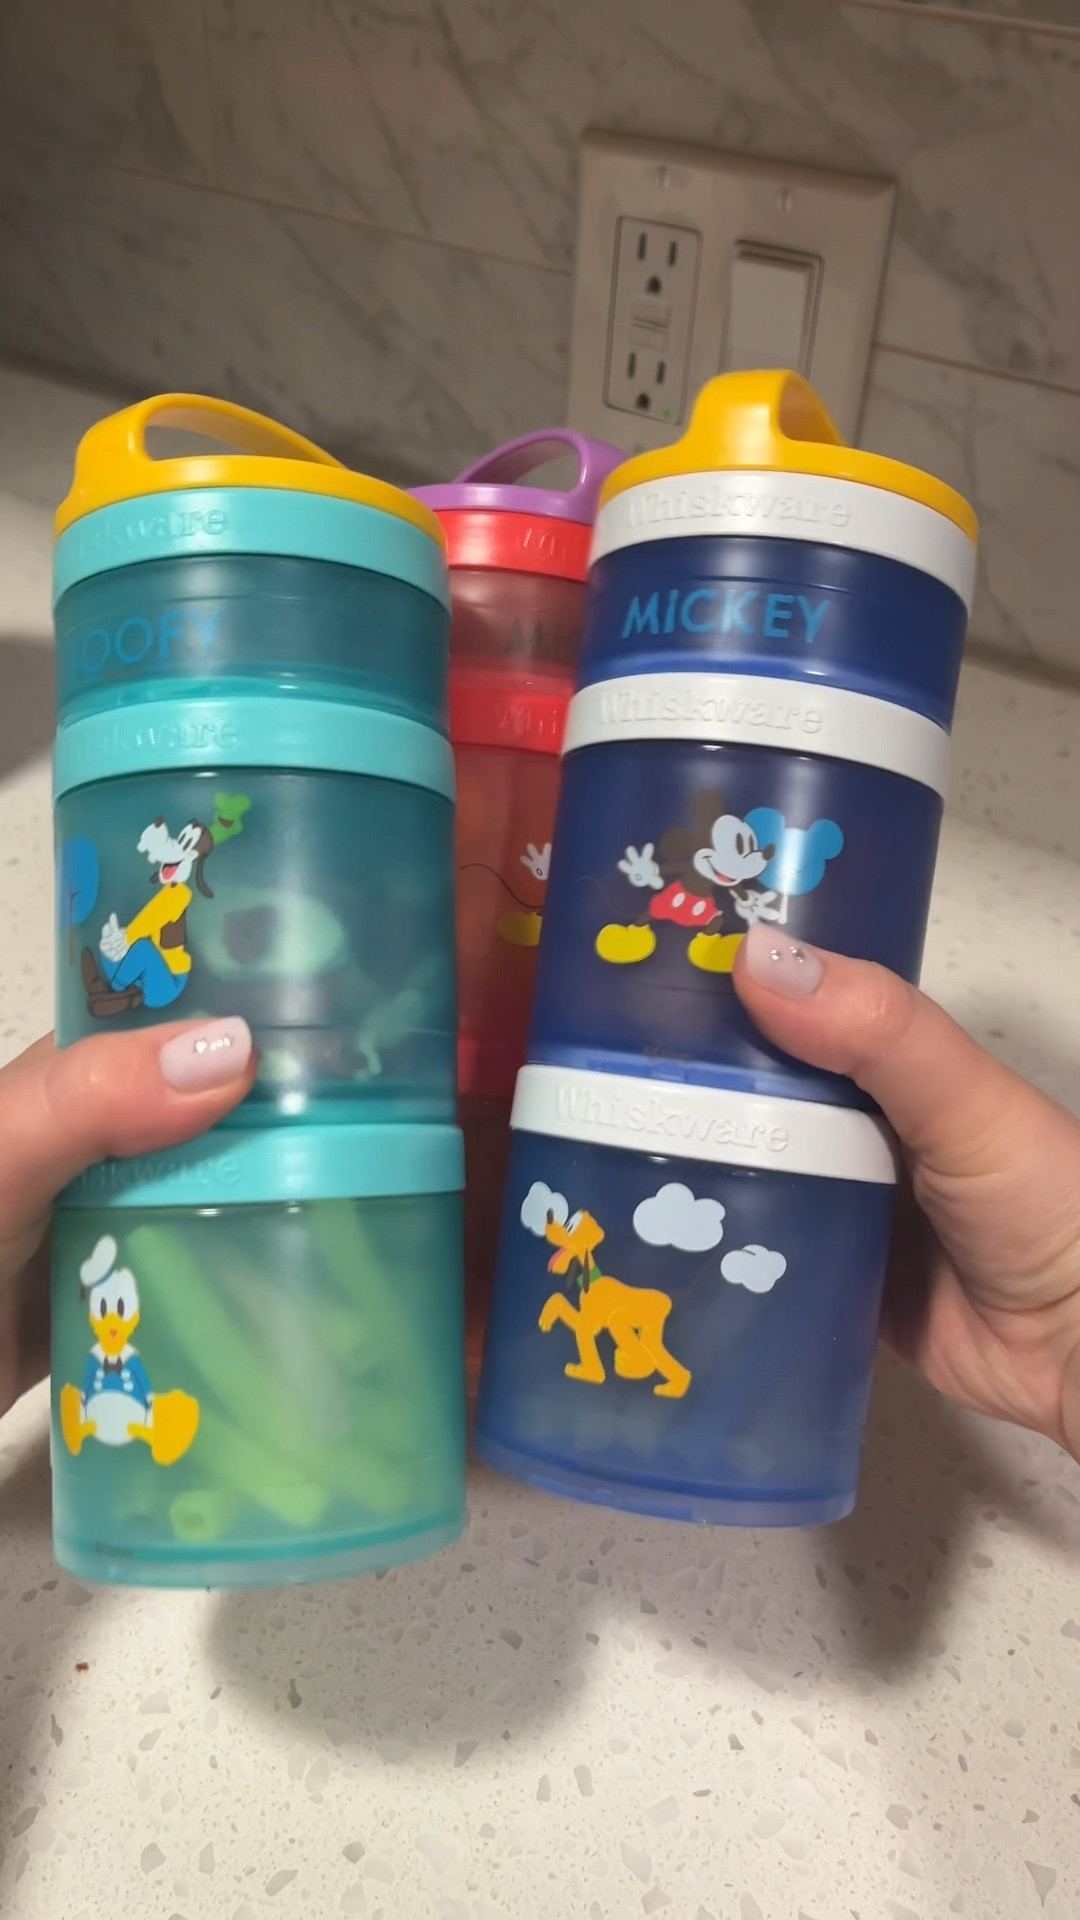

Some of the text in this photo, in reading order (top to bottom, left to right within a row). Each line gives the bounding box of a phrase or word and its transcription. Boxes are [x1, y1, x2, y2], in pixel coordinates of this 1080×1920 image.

[627, 485, 853, 528] Whiskware
[620, 588, 832, 644] MICKEY
[599, 687, 824, 735] Whiskware
[555, 1085, 790, 1153] Whiskware
